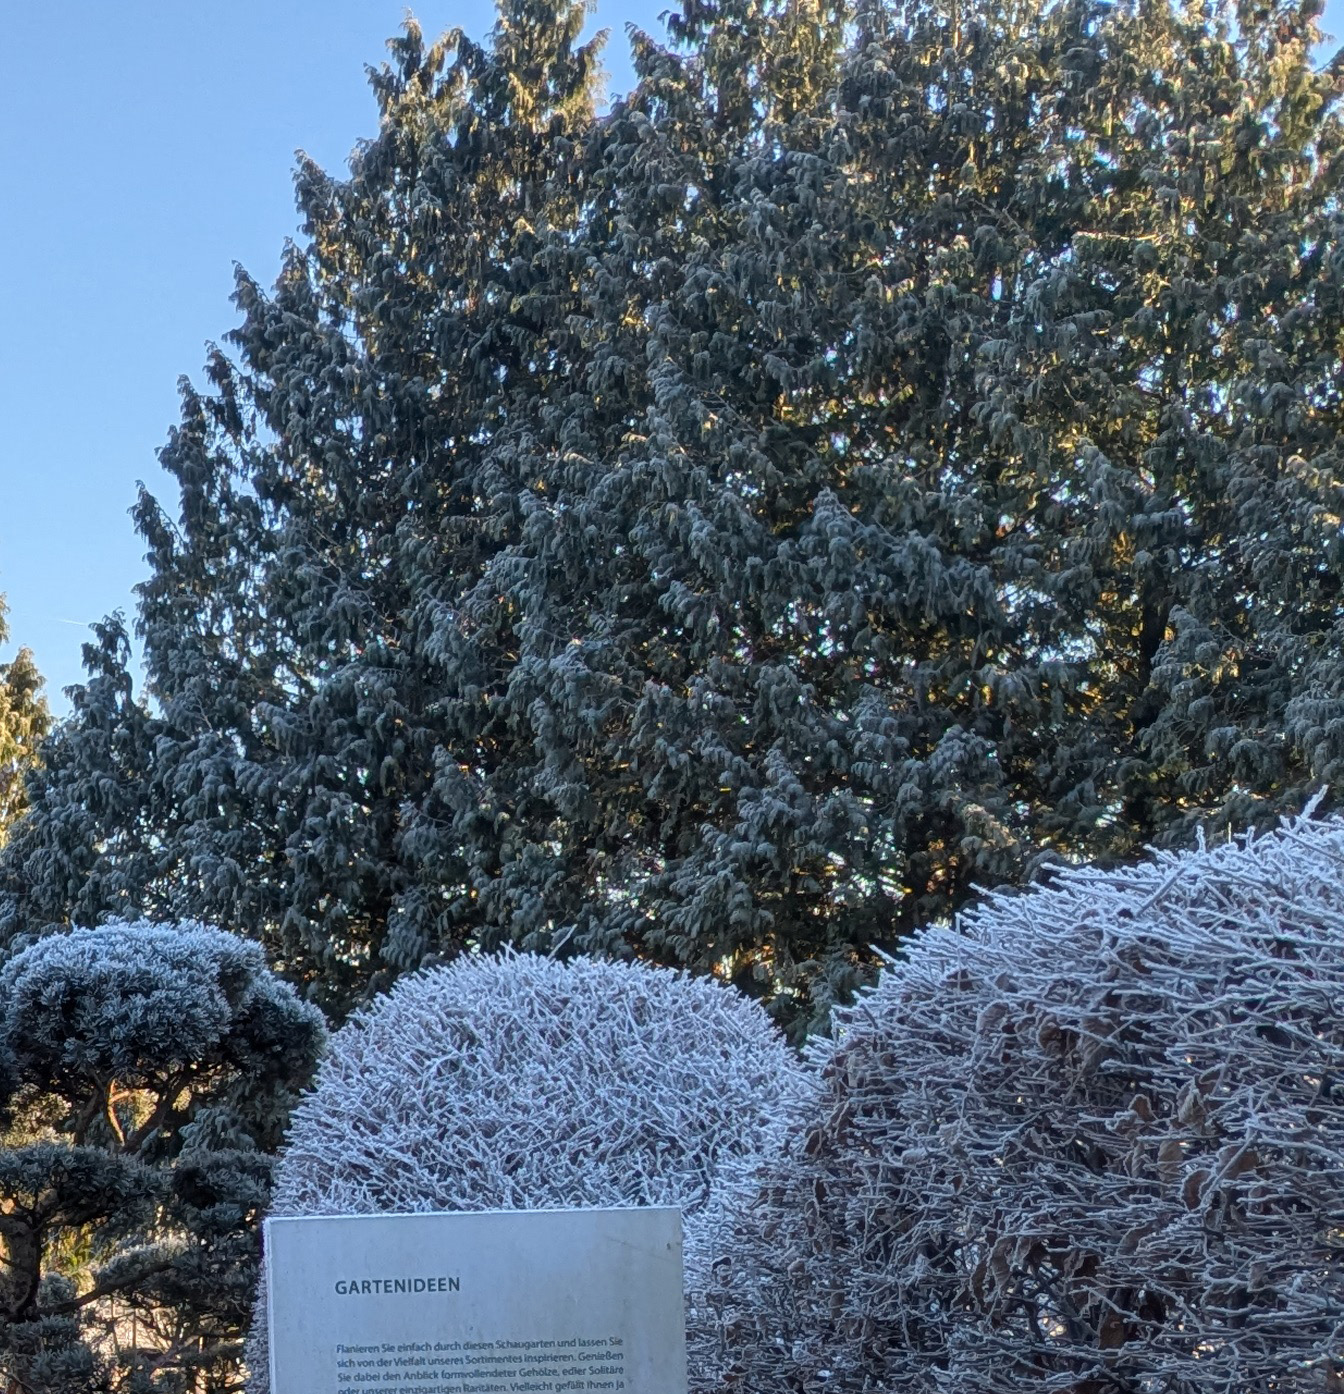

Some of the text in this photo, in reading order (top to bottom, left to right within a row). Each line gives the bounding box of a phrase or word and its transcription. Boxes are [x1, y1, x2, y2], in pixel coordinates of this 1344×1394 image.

[335, 1277, 460, 1295] GARTENIDEEN
[336, 1337, 623, 1353] Flanieren Sie einfach durch diesen Schaugarten und lassen Sie
[337, 1359, 355, 1368] sich
[377, 1358, 392, 1366] der
[394, 1357, 426, 1366] Vielfalt
[428, 1357, 463, 1365] unseres
[465, 1355, 522, 1364] Sortimentes
[524, 1354, 576, 1363] inspirieren.
[578, 1351, 623, 1361] Genießen
